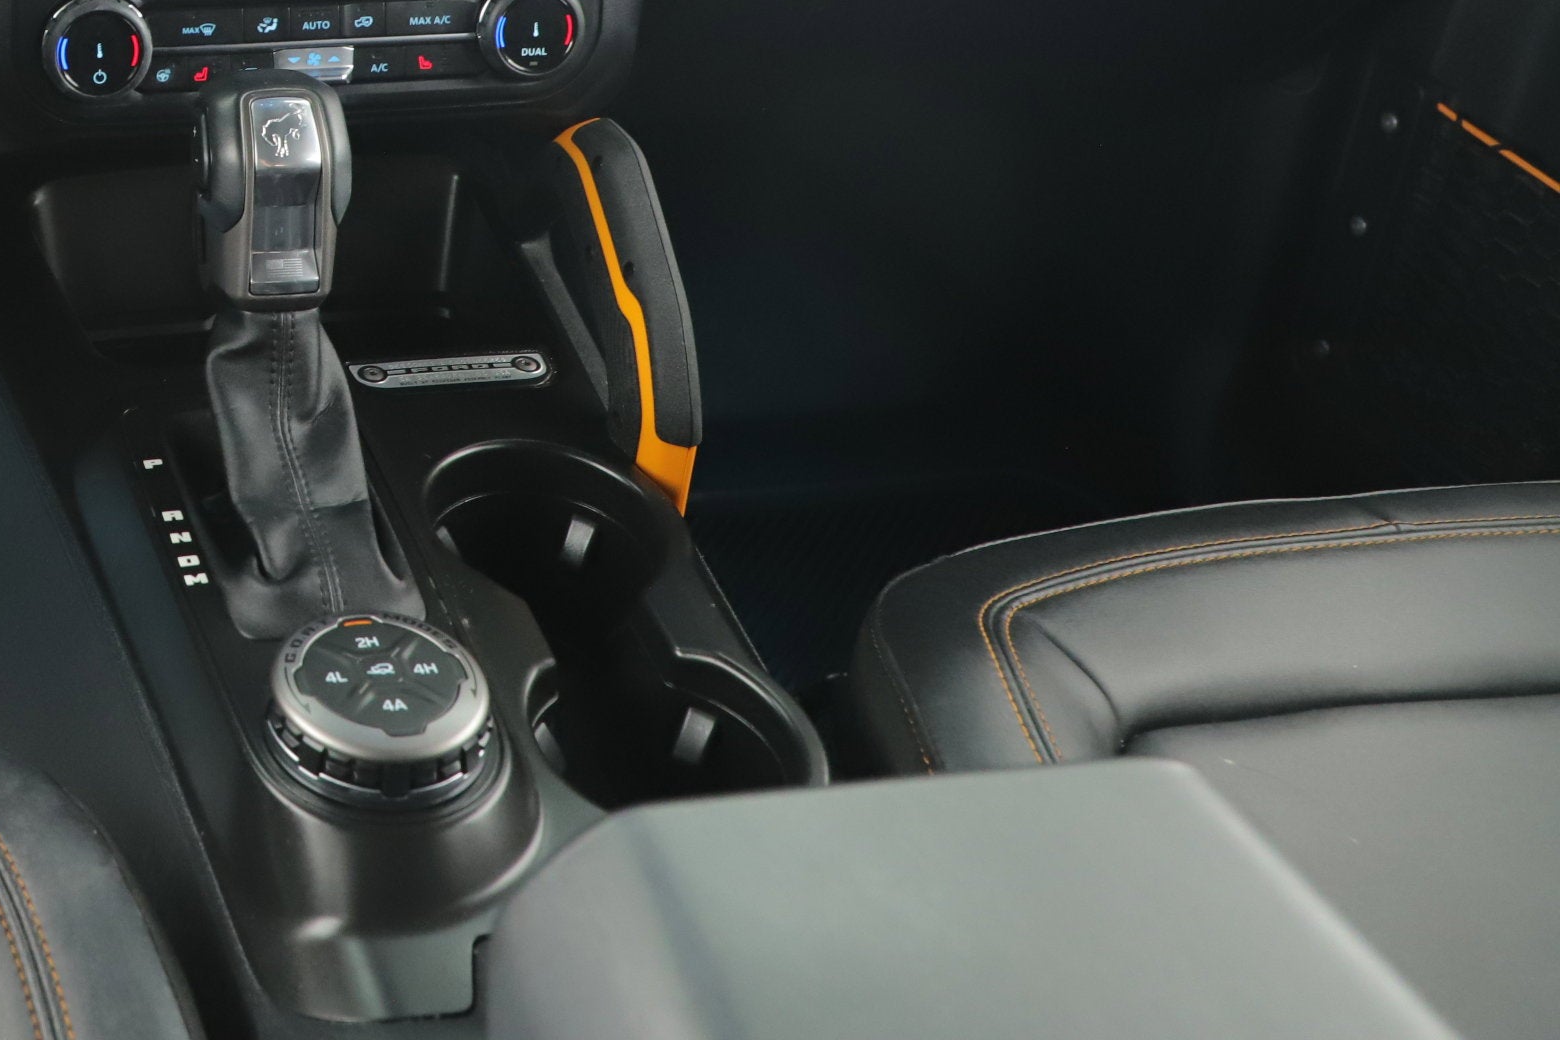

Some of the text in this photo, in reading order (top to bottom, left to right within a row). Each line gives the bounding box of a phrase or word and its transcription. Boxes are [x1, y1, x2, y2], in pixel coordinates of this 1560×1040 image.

[302, 20, 331, 30] AUTO
[409, 15, 451, 26] MAX A/C
[182, 26, 200, 35] MAX
[521, 47, 547, 57] DUAL
[370, 63, 389, 73] A/C
[143, 458, 163, 470] P
[169, 531, 192, 544] N
[183, 572, 209, 586] M
[354, 636, 380, 649] 2H
[413, 662, 439, 675] 4H
[325, 671, 349, 683] 4L
[382, 698, 408, 712] 4A
